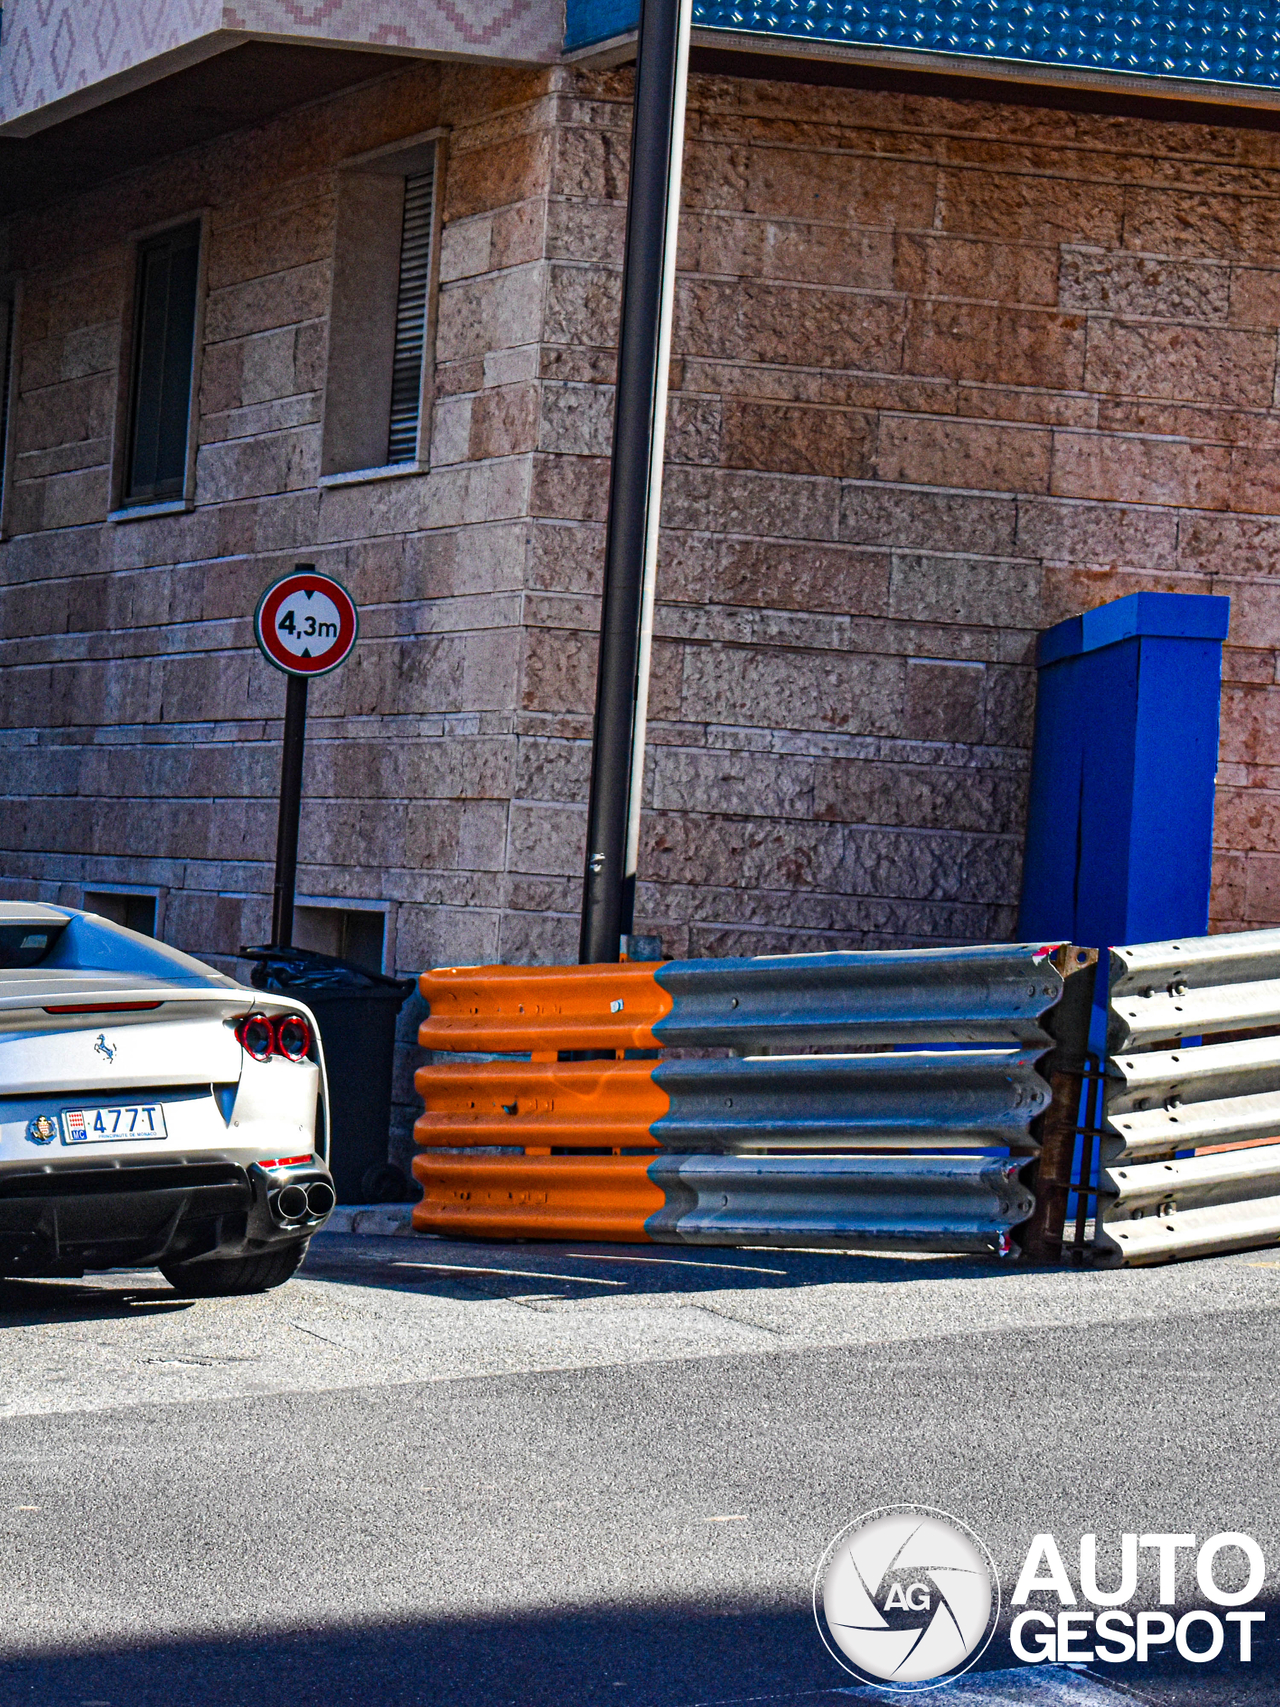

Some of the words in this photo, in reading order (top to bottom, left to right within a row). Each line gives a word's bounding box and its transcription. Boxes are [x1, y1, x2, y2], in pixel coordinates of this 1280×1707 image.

[278, 610, 338, 639] 4,3m
[93, 1107, 156, 1133] 477T
[73, 1130, 85, 1139] MC
